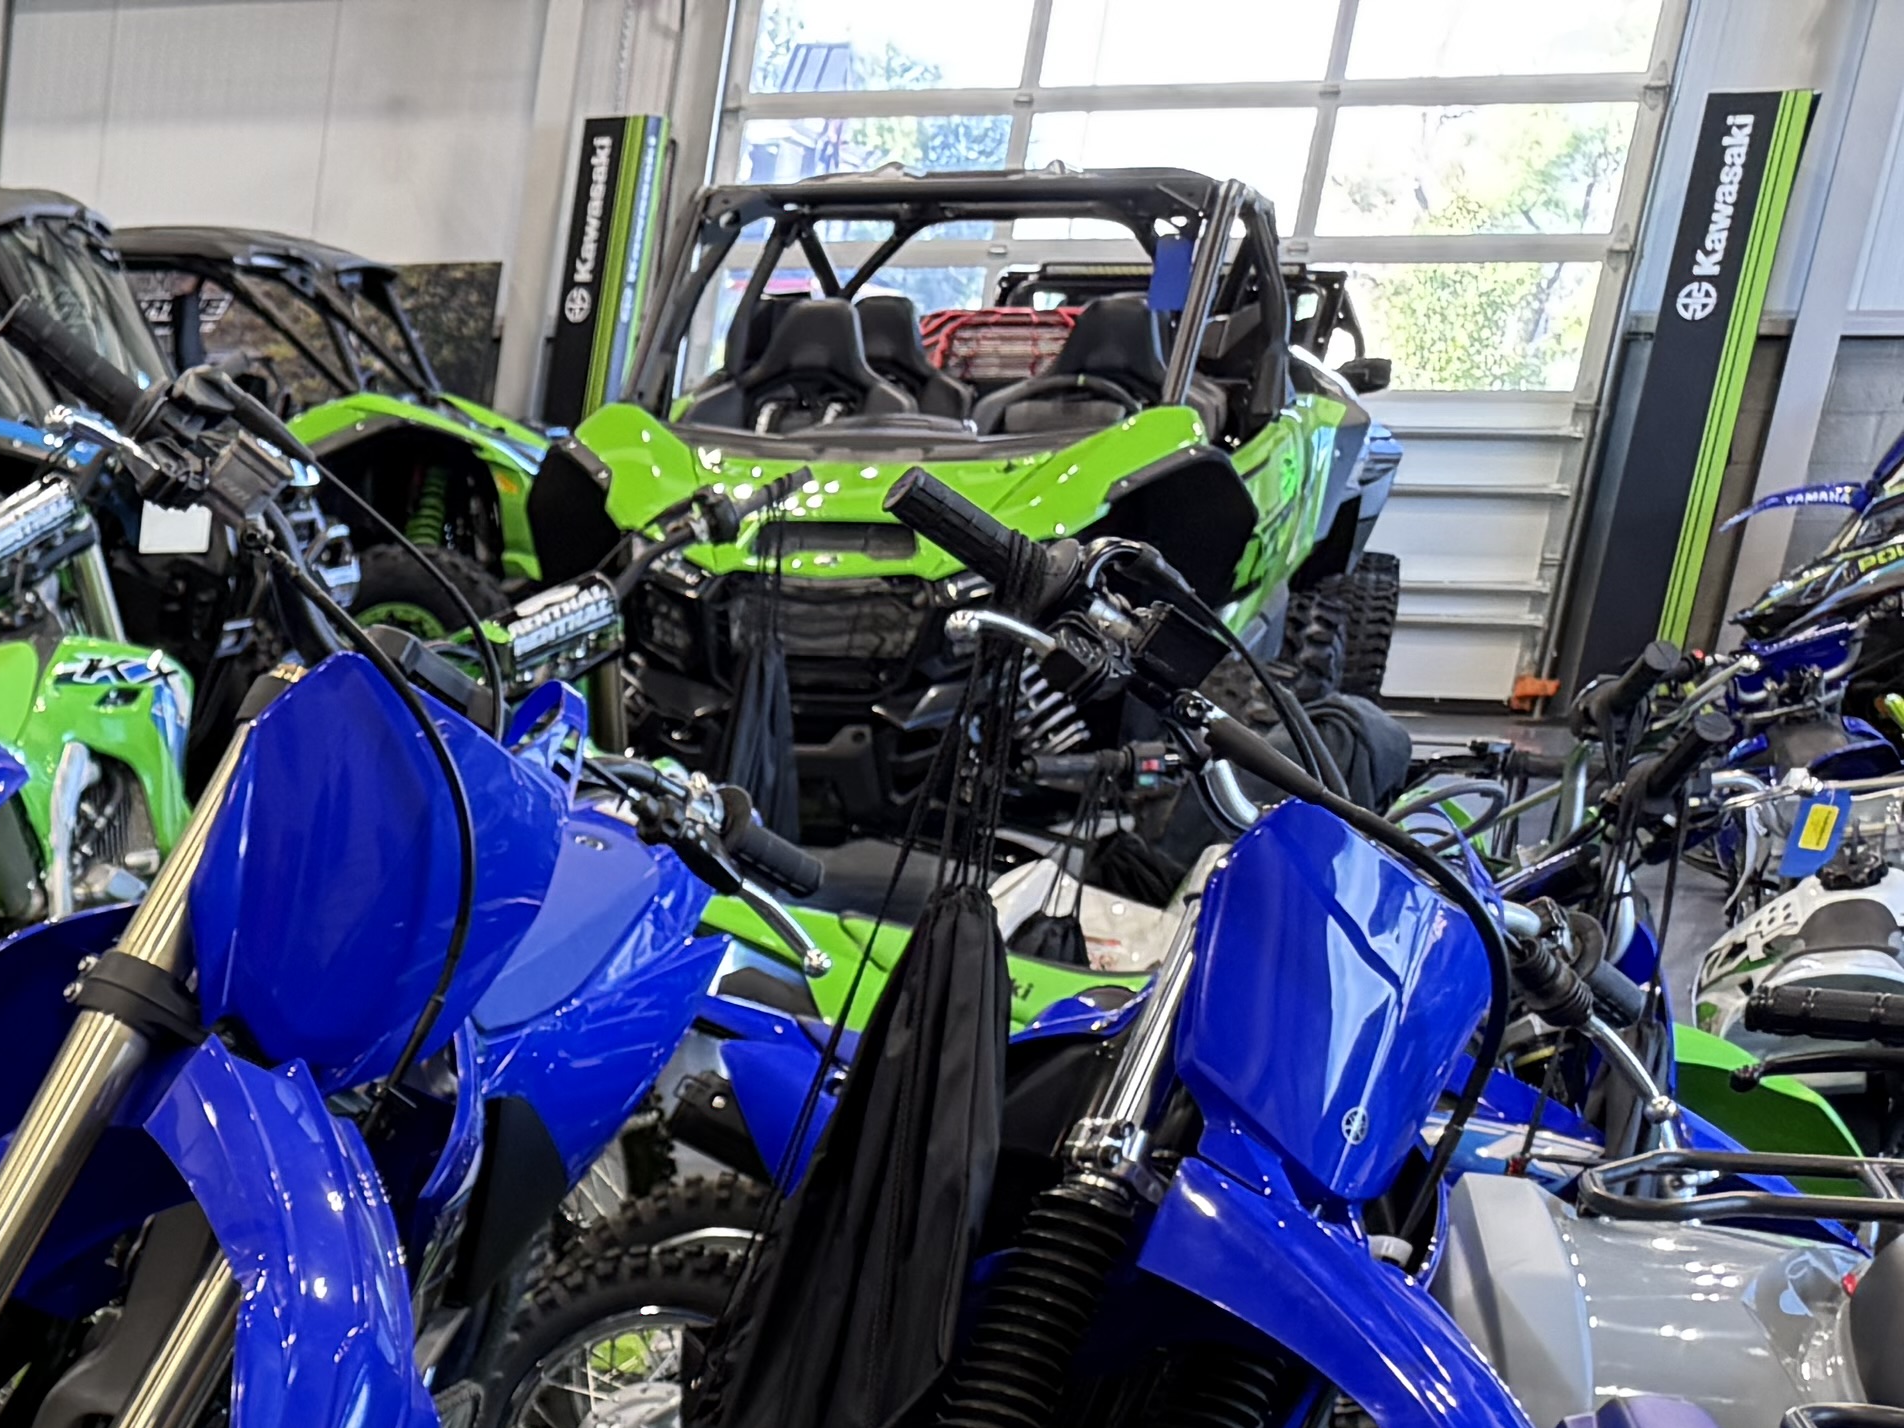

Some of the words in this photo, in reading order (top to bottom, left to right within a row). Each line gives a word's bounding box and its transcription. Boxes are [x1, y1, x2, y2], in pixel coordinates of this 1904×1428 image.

[573, 135, 612, 283] Kawasaki
[1692, 114, 1755, 277] Kawasaki
[1785, 488, 1851, 505] YAMAHA
